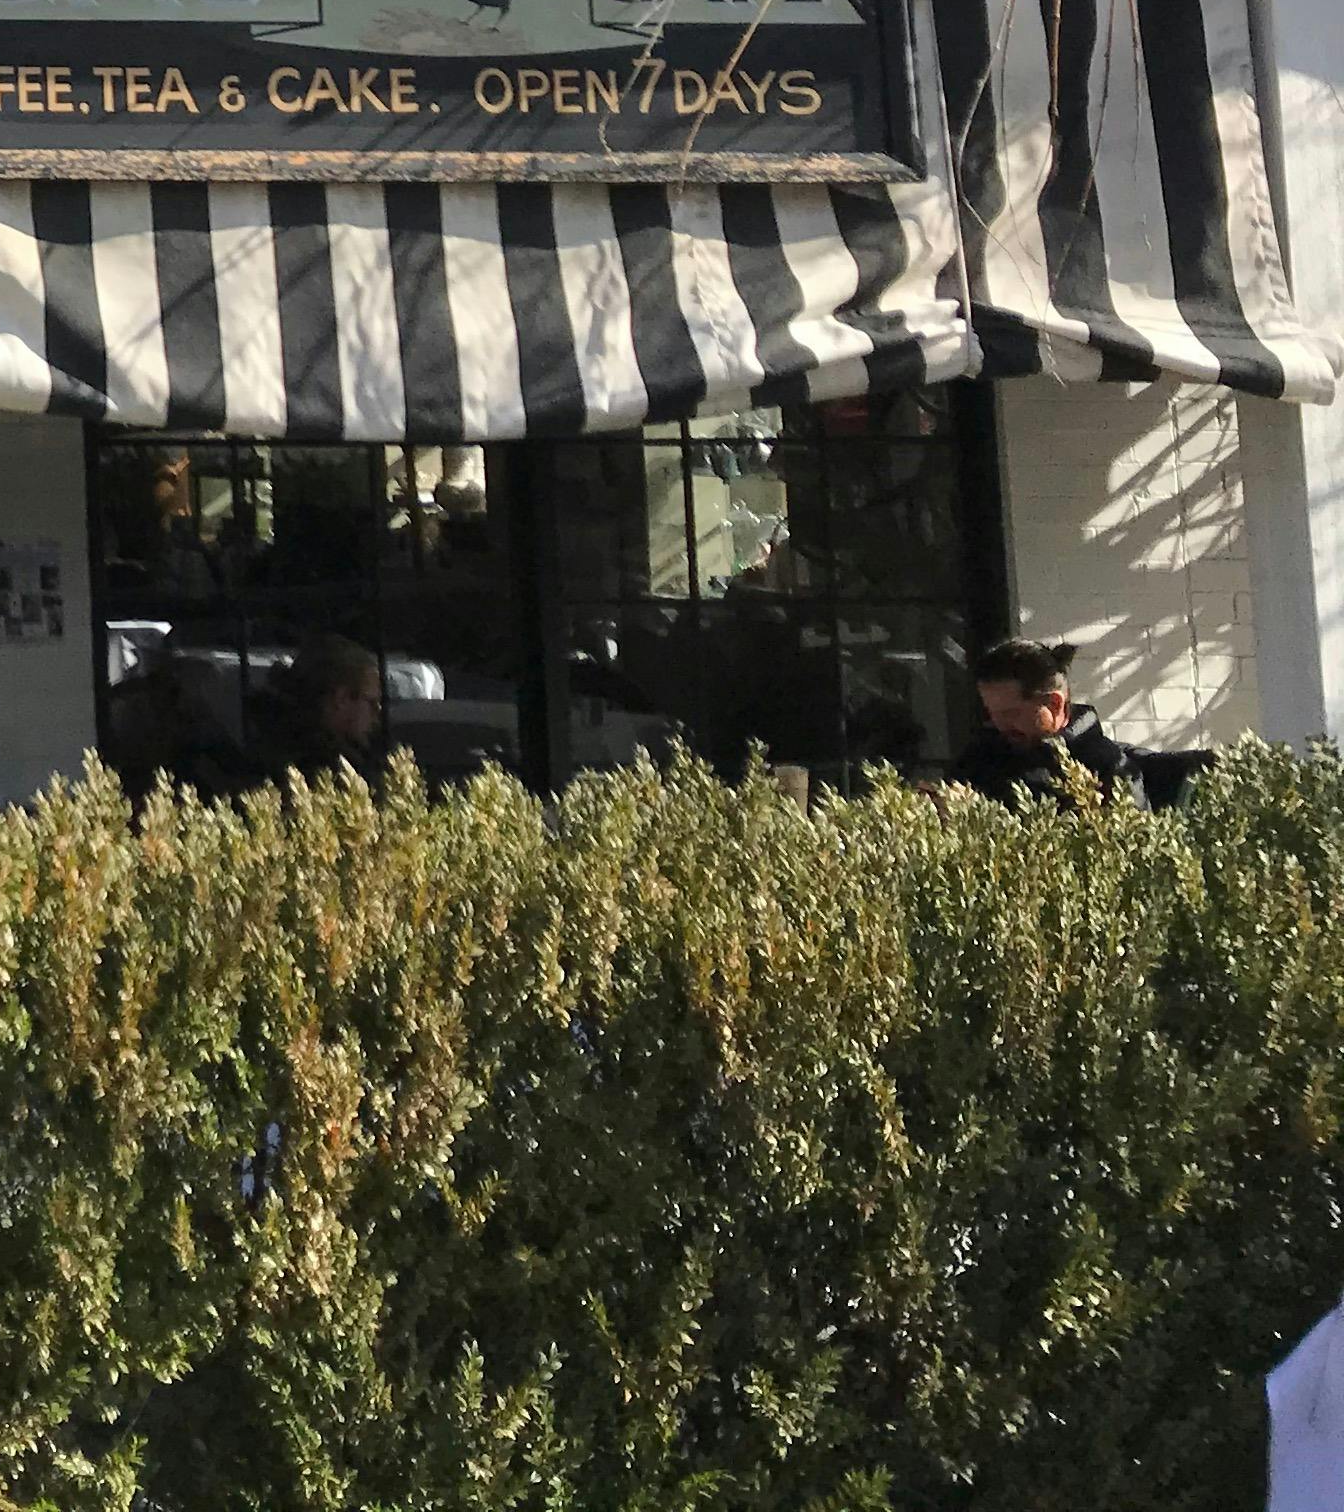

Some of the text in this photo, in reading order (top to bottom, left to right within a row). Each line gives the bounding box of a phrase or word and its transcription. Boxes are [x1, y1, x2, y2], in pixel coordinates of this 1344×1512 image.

[219, 74, 245, 114] &
[474, 68, 621, 115] OPEN
[633, 58, 666, 114] 7
[673, 70, 822, 115] DAYS
